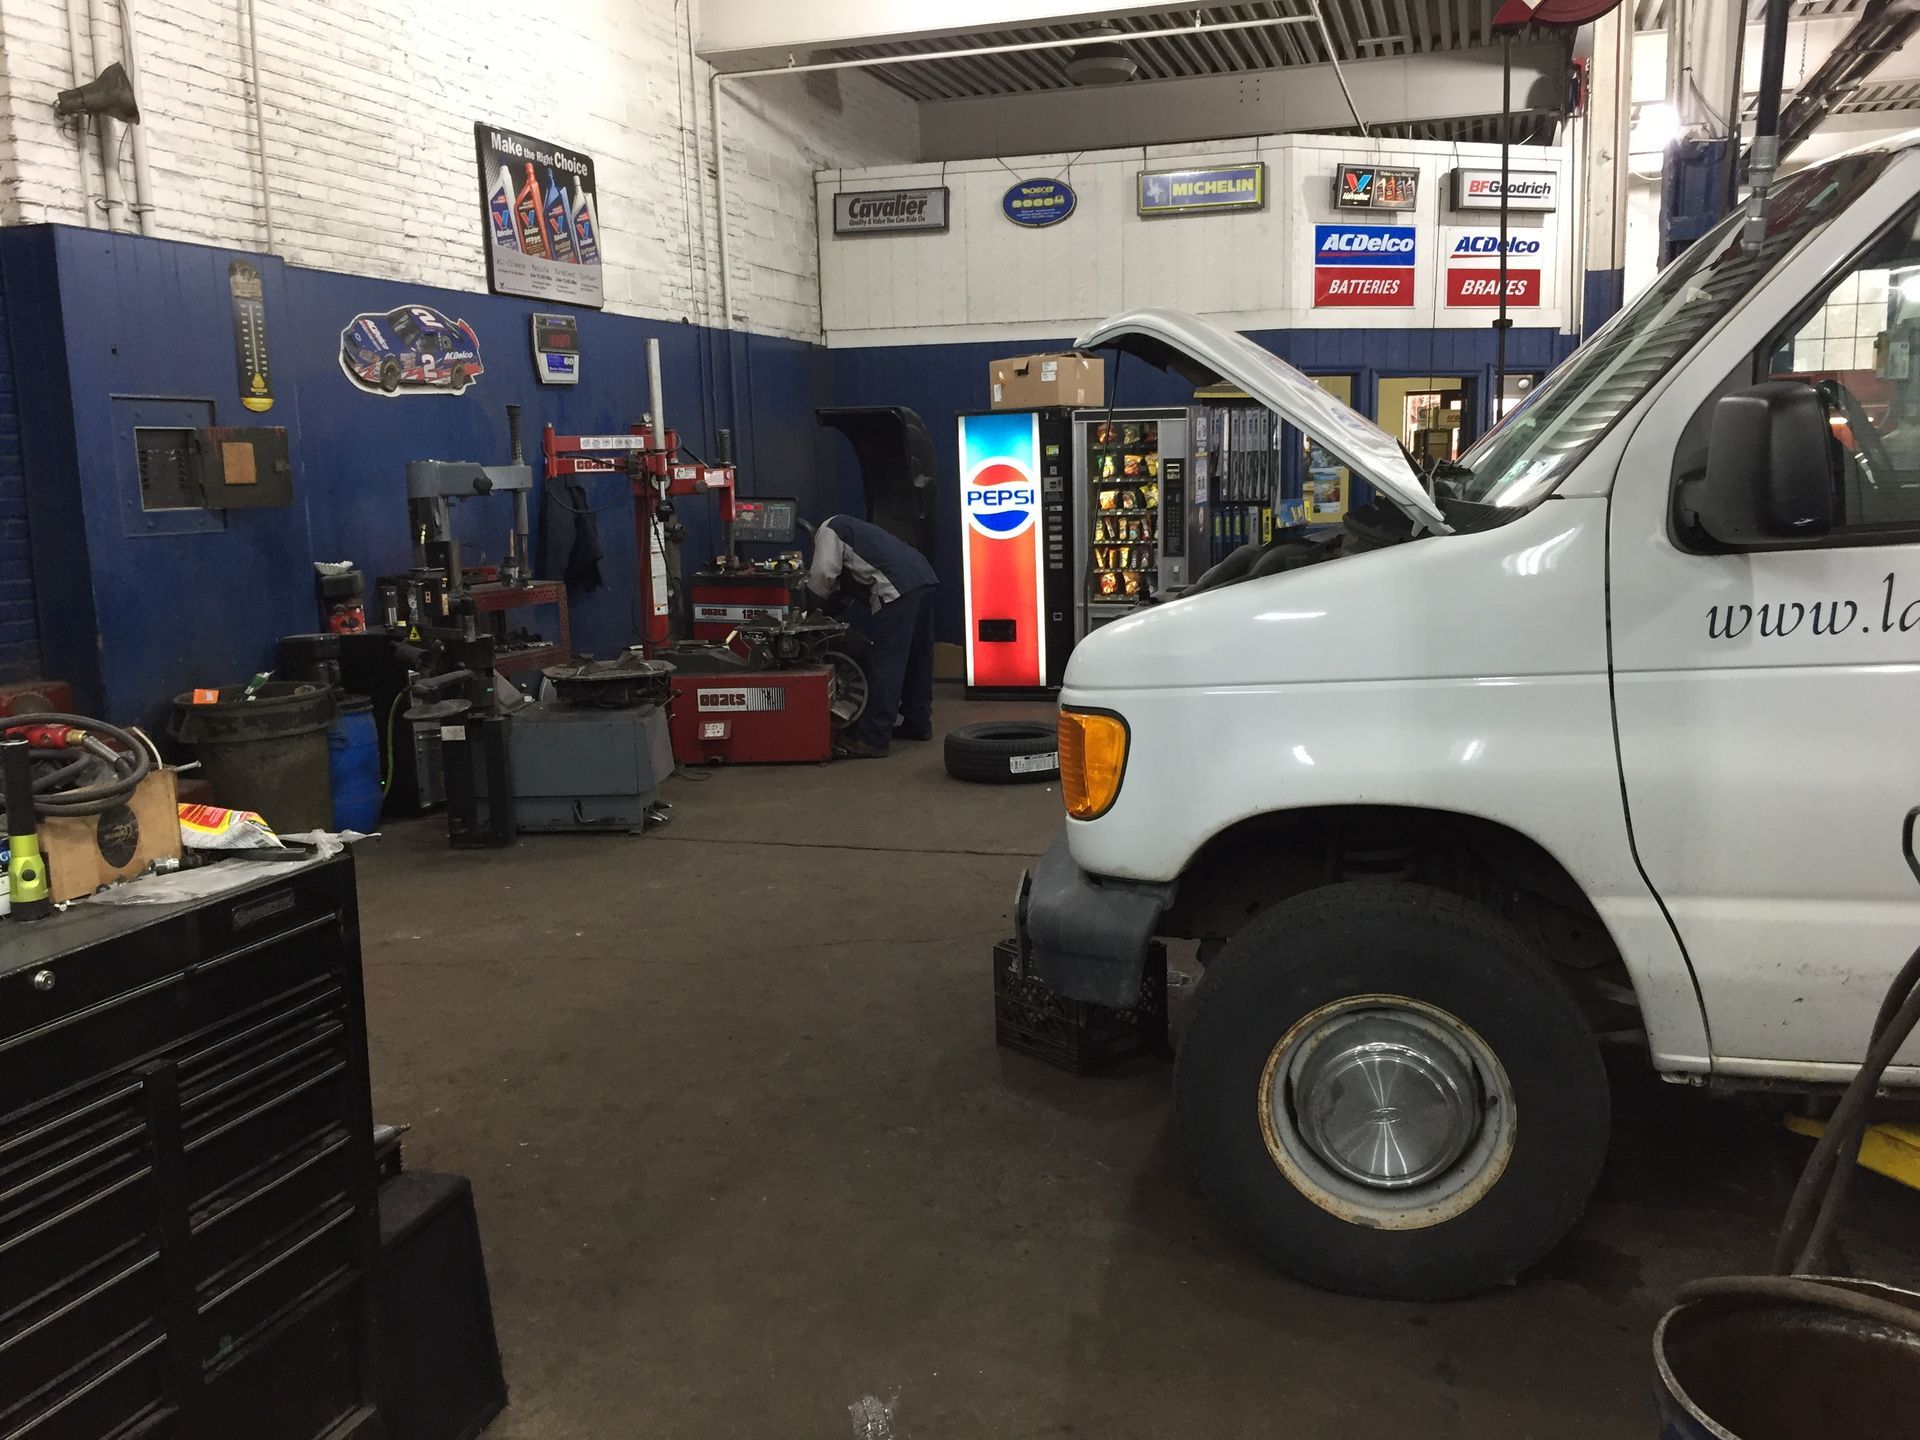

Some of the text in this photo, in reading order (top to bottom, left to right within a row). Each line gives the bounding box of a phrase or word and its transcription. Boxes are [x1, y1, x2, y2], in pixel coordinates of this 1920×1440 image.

[491, 132, 588, 176] Make the Right Choice
[1172, 178, 1254, 196] MICHELIN
[1468, 180, 1551, 194] BFGodrich
[848, 194, 927, 218] Cavalier
[849, 218, 867, 226] Quality
[1321, 233, 1414, 252] ACDelco
[1328, 279, 1400, 294] BATTERIES
[1461, 279, 1528, 295] BRAES
[411, 308, 444, 328] 2
[444, 351, 473, 360] ACDelco
[421, 354, 438, 378] 2
[967, 489, 1034, 506] PEPSI
